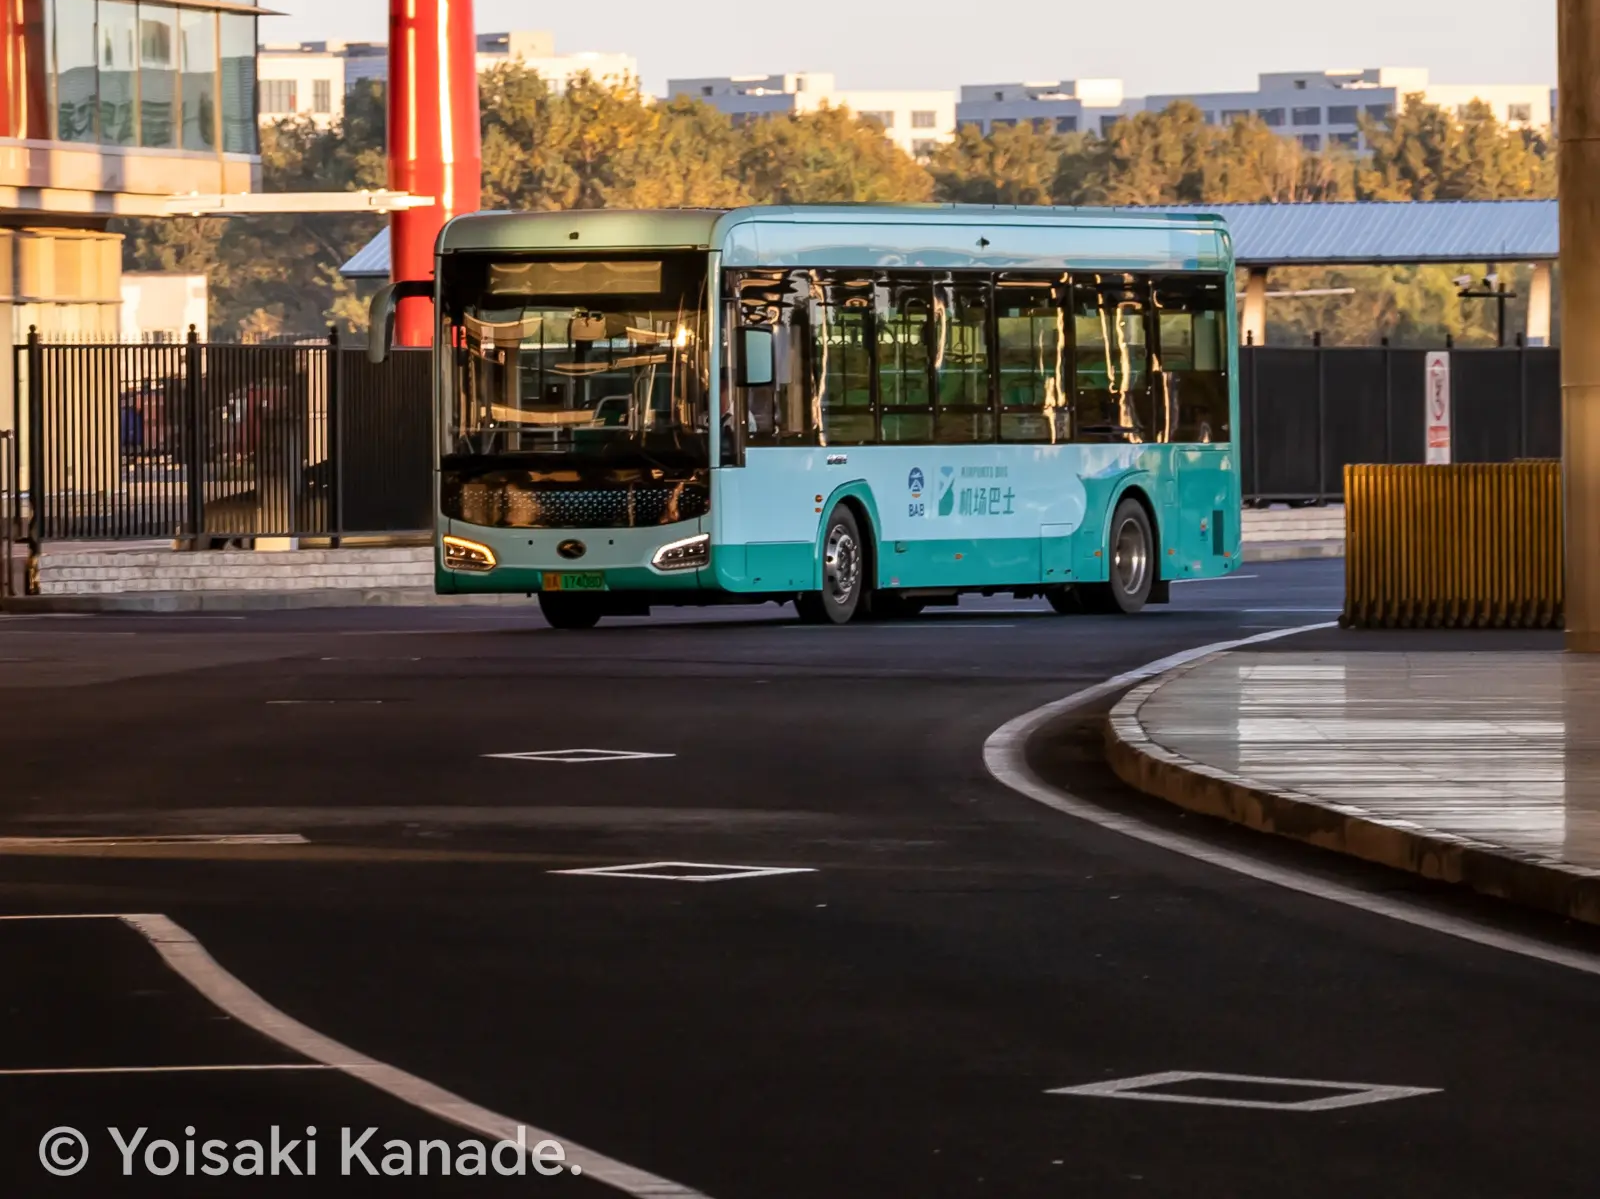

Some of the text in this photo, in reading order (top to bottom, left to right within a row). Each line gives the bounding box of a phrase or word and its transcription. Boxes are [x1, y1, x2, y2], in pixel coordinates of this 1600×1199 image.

[908, 503, 925, 517] BAB
[959, 486, 1016, 516] 机场巴士
